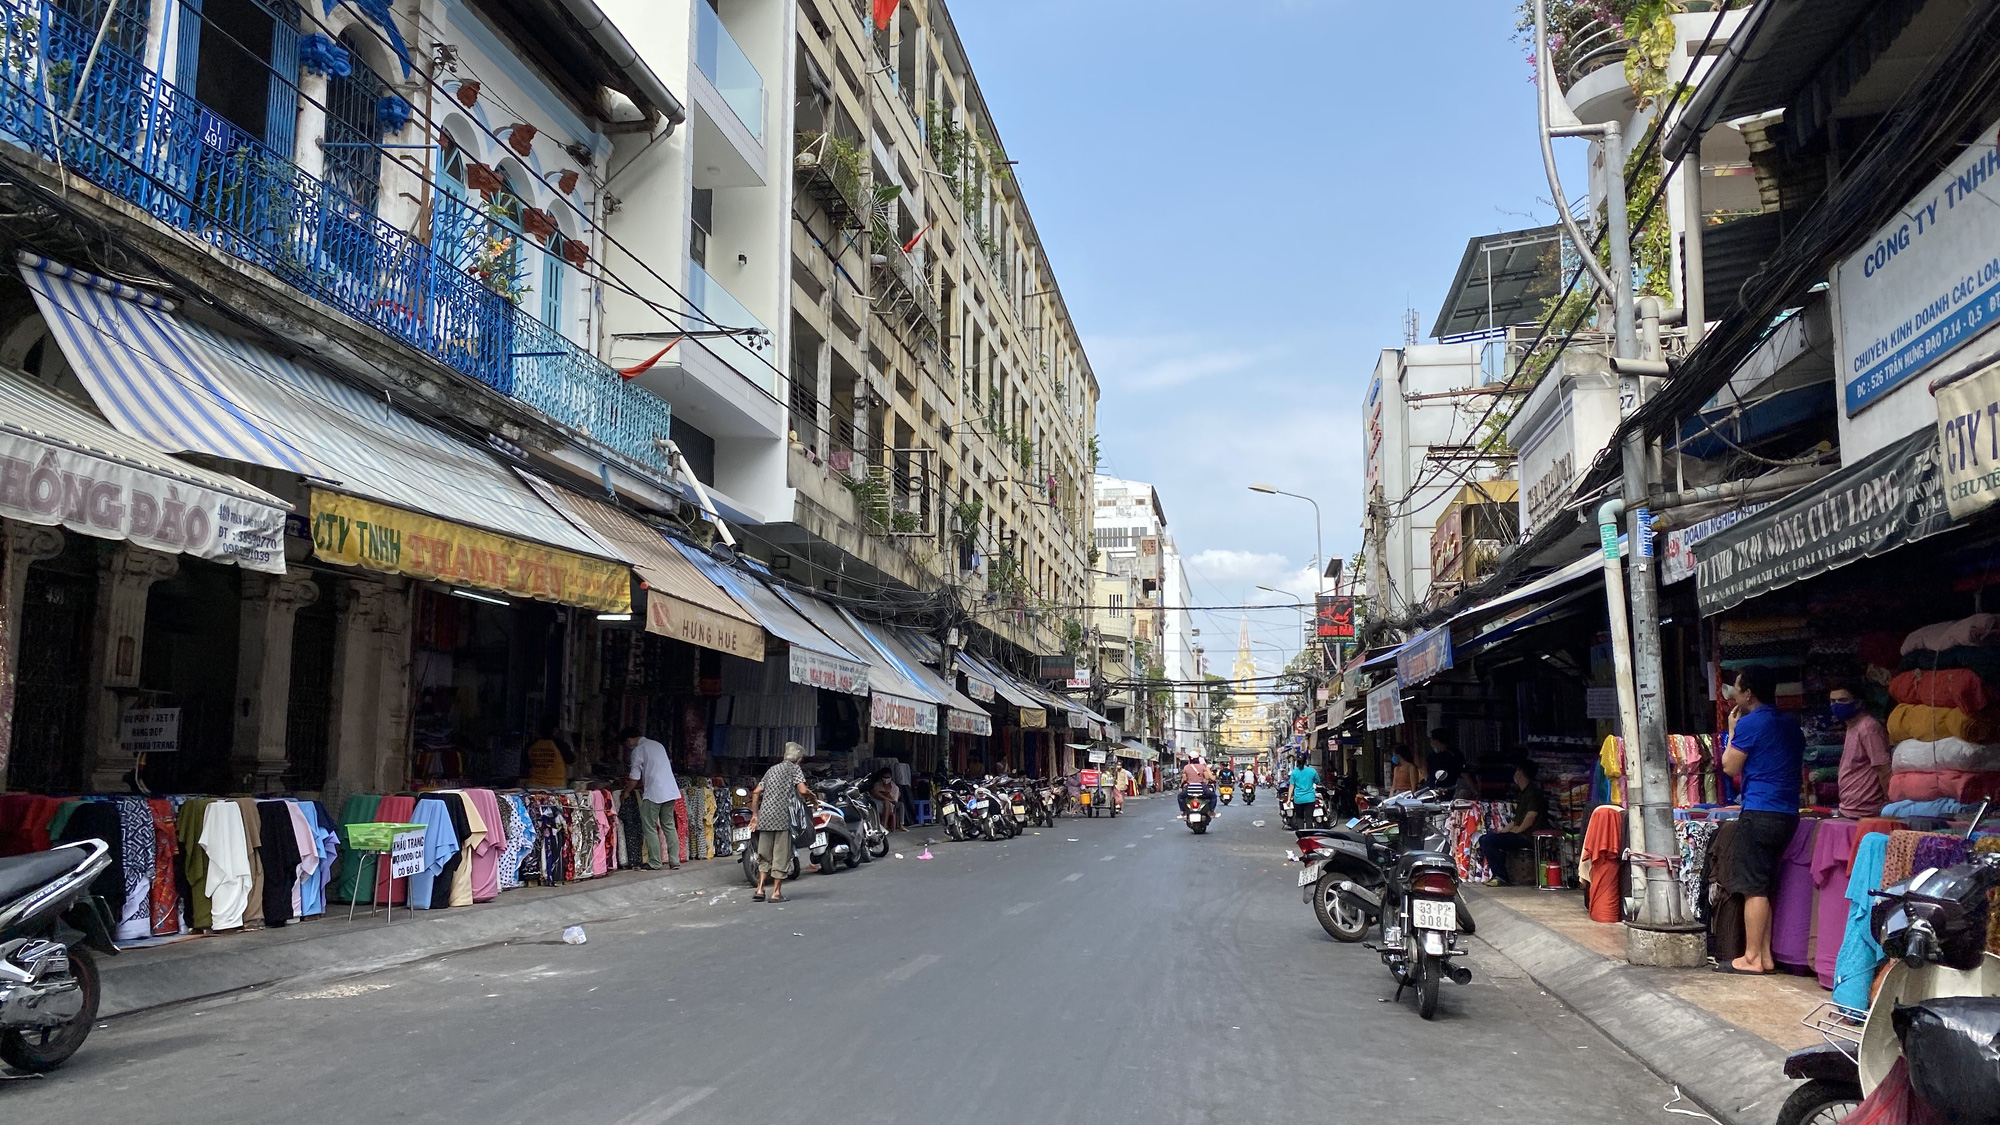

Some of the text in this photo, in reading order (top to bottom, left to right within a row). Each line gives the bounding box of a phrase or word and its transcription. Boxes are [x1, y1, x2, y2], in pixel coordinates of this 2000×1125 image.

[205, 130, 222, 150] 491
[209, 117, 221, 135] L1
[1864, 147, 2000, 278] CÔNG TY TNHH
[1854, 337, 1888, 373] CHUYÊN
[1891, 319, 1913, 348] KINH
[1915, 293, 1949, 331] DOANH
[1952, 277, 1974, 305] CÁC
[1871, 370, 1884, 390] 526
[1885, 353, 1903, 381] TRẦN
[1904, 343, 1925, 369] HƯNG
[1925, 331, 1942, 354] ĐẠO
[1943, 319, 1961, 343] P.14
[1968, 305, 1983, 328] Q.5
[1945, 409, 1981, 475] CTY
[129, 482, 212, 550] ĐÀO
[218, 526, 228, 539] ĐT
[1684, 523, 1709, 546] DOANH
[1766, 513, 1806, 560] SÔNG
[1846, 469, 1900, 527] LONG
[314, 511, 350, 554] CTY
[356, 520, 401, 564] TNHH
[407, 532, 512, 588] THANH
[1420, 915, 1450, 929] 9084
